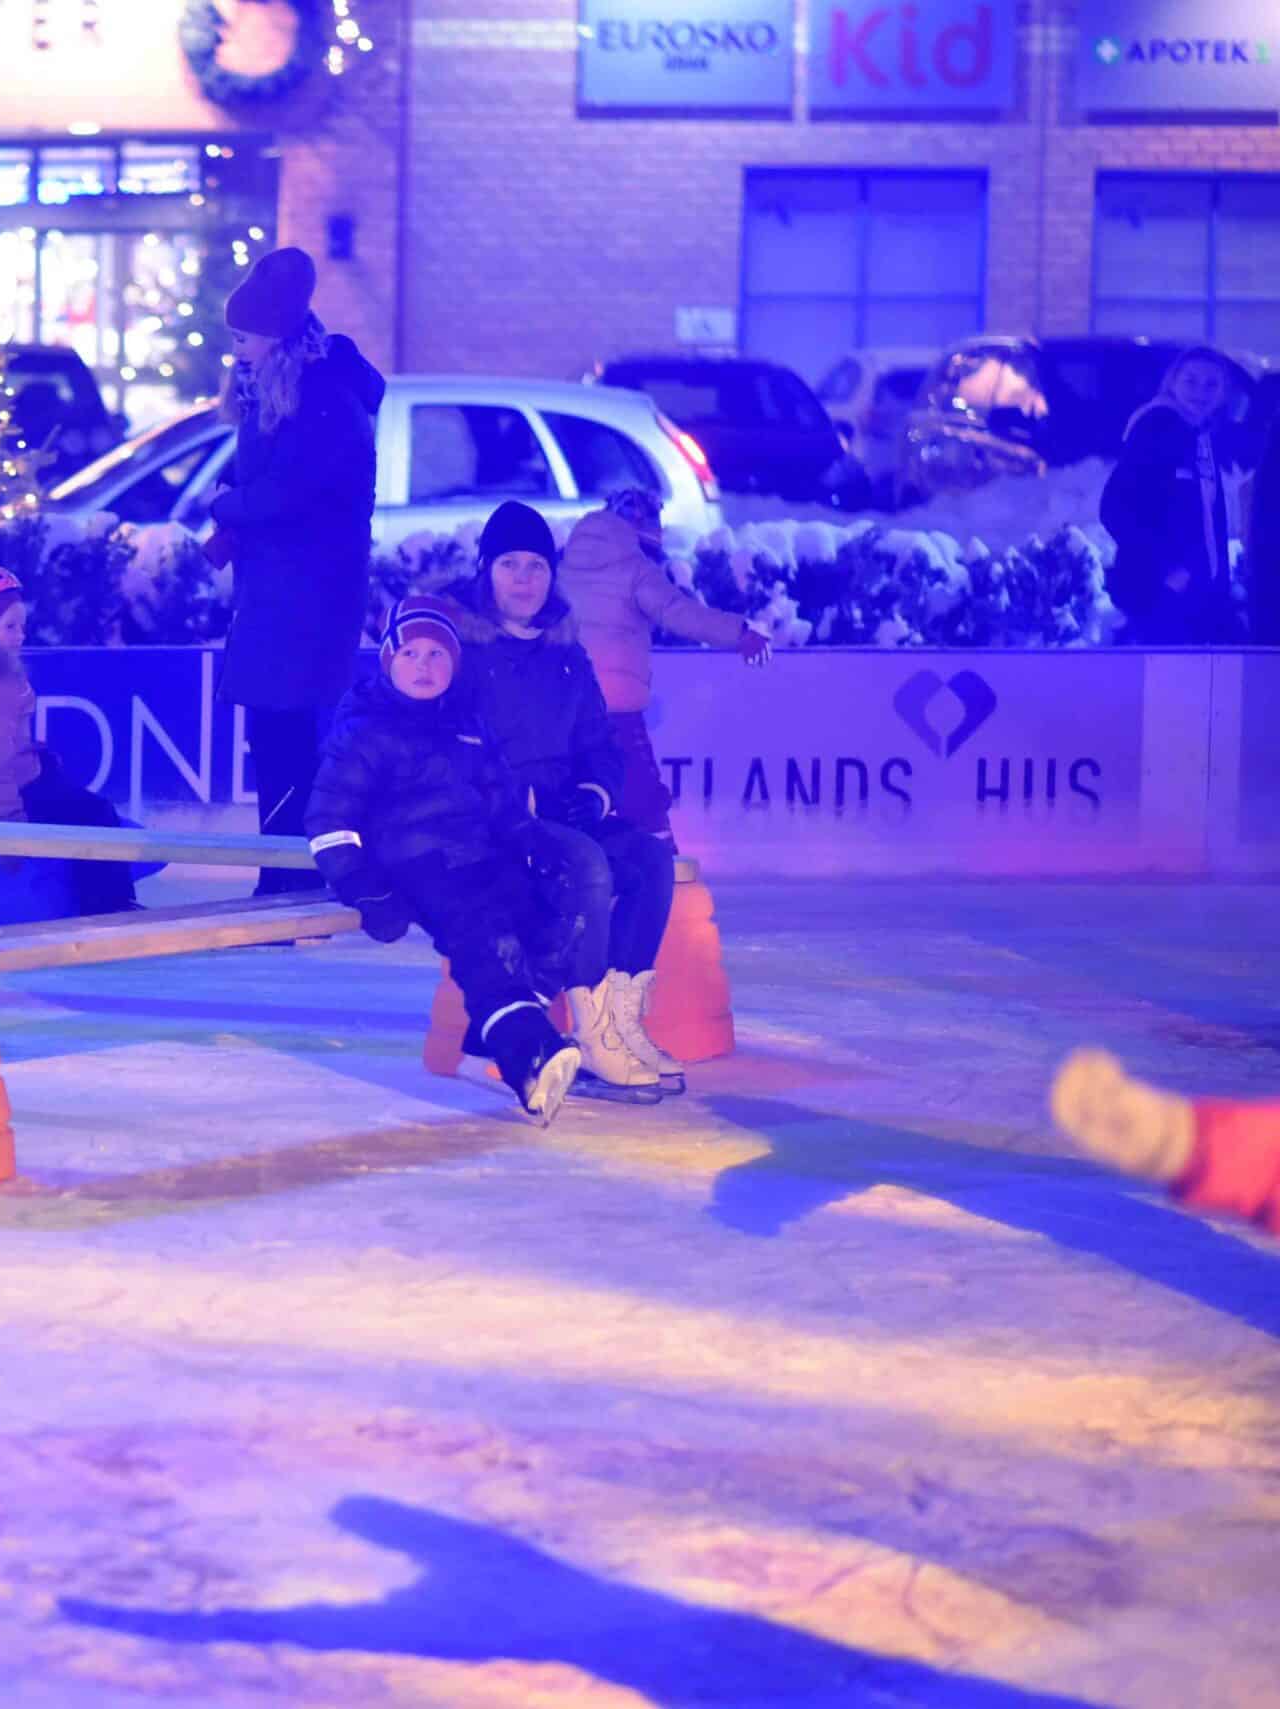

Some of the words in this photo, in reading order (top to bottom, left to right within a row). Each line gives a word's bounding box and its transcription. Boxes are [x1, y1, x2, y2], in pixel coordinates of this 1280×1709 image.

[597, 20, 779, 52] EUROSKO
[830, 4, 992, 90] Kid
[1125, 37, 1249, 64] APOTEK
